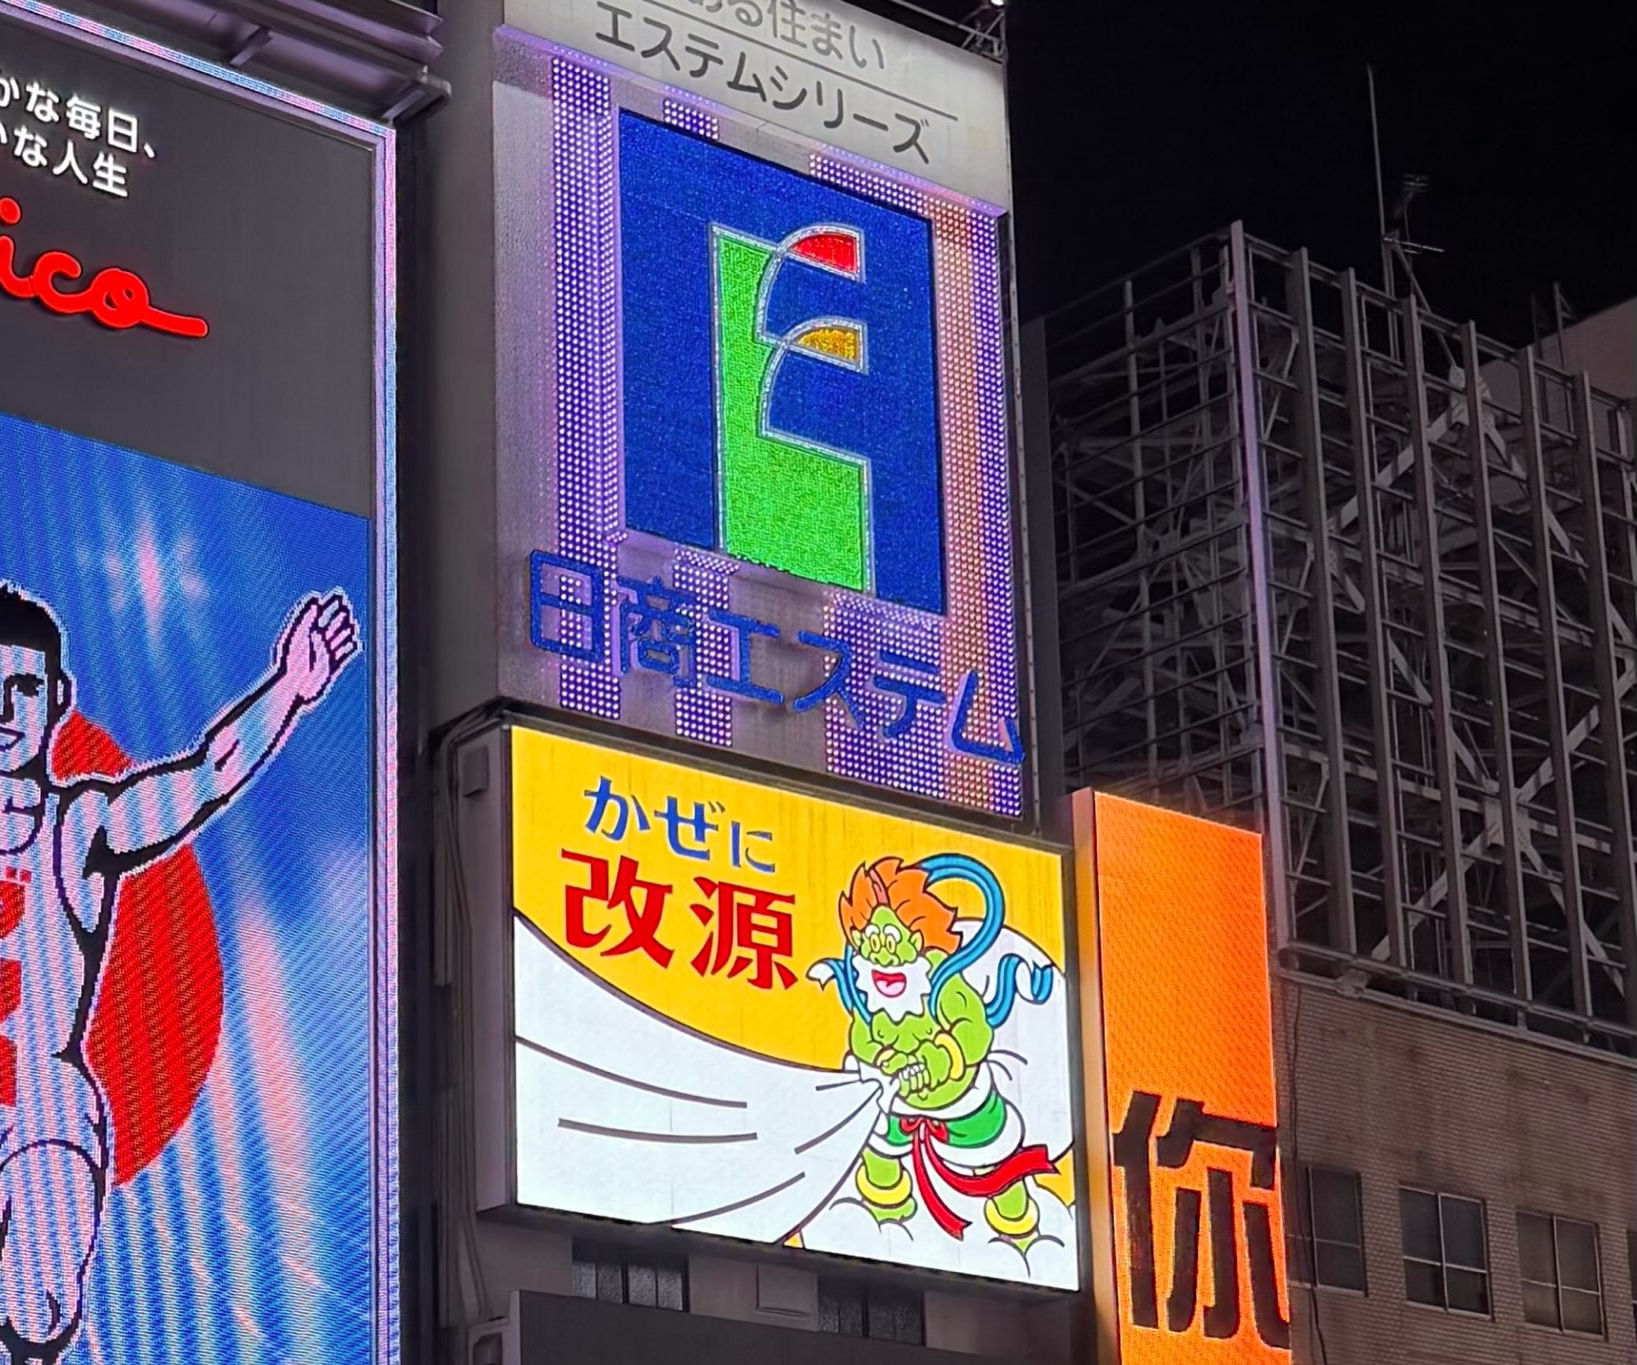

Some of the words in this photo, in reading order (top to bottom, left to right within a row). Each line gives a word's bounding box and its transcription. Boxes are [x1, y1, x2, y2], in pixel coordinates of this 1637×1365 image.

[595, 1, 929, 164] エステムシリーズ
[525, 548, 1024, 766] 日商エステム
[584, 776, 775, 873] かぜに
[560, 849, 797, 990] 改源
